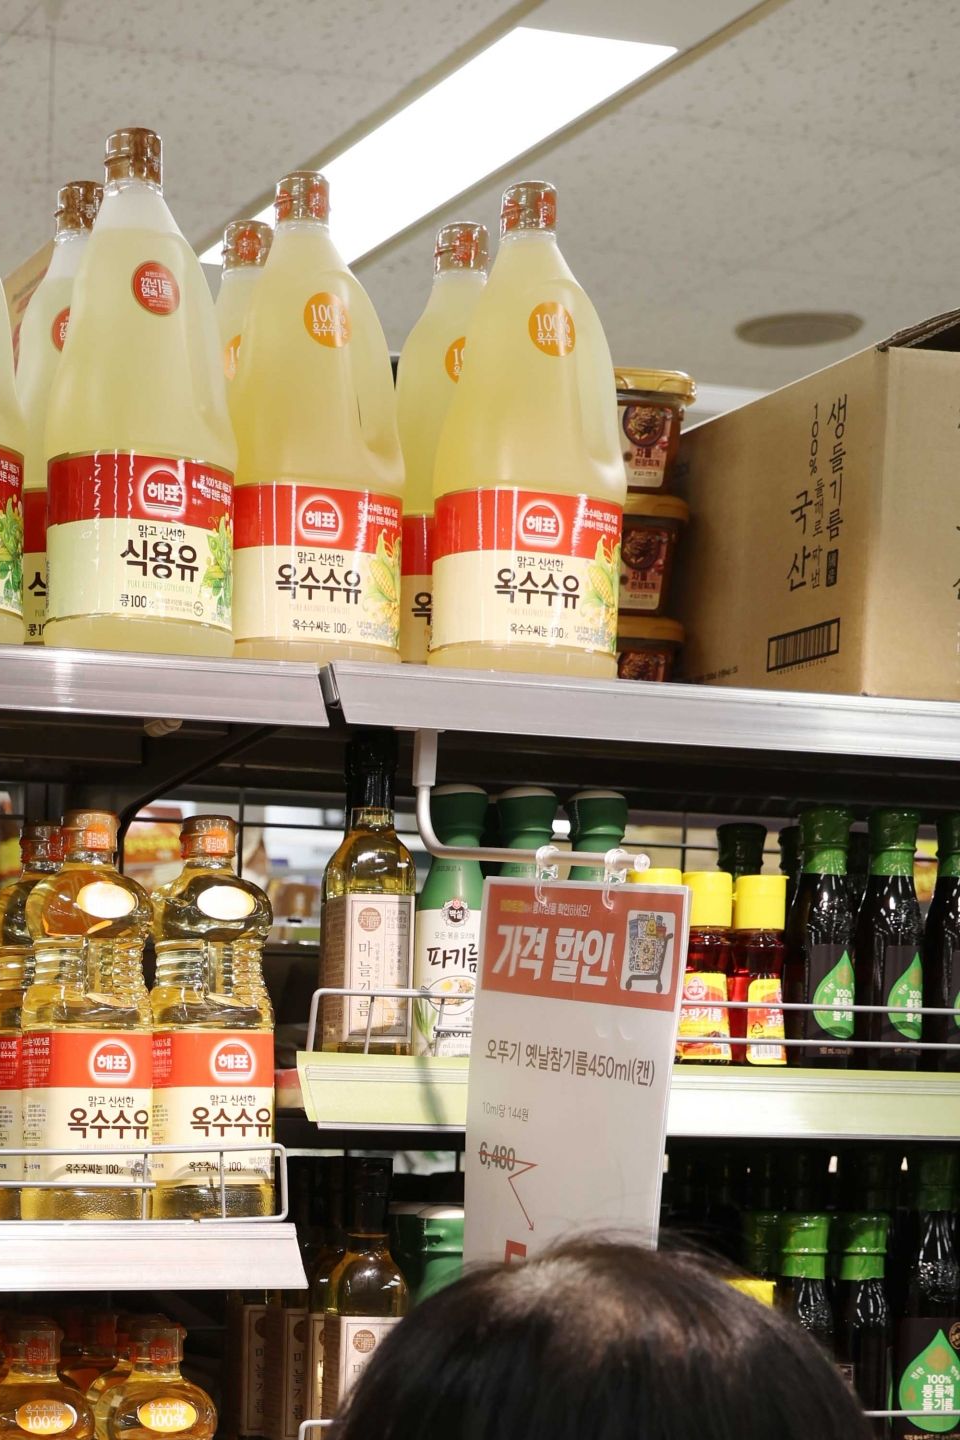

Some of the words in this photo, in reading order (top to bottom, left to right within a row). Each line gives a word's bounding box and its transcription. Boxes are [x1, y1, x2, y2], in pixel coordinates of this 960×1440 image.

[825, 393, 848, 543] 생들기름
[786, 490, 813, 592] 국산
[120, 539, 199, 582] 식용유
[275, 563, 362, 605] 옥수수유
[494, 568, 580, 609] 옥수수유
[292, 618, 331, 634] 옥수수씨눈
[426, 944, 478, 973] 파기름
[492, 924, 549, 981] 가격
[551, 927, 615, 987] 할인
[356, 940, 373, 1018] 마늘기름
[485, 1039, 521, 1066] 오뚜기
[67, 1107, 149, 1139] 옥수수유
[190, 1106, 272, 1138] 옥수수유
[482, 1102, 506, 1119] 10ml당
[508, 1106, 529, 1122] 144원
[479, 1141, 516, 1171] 6,480
